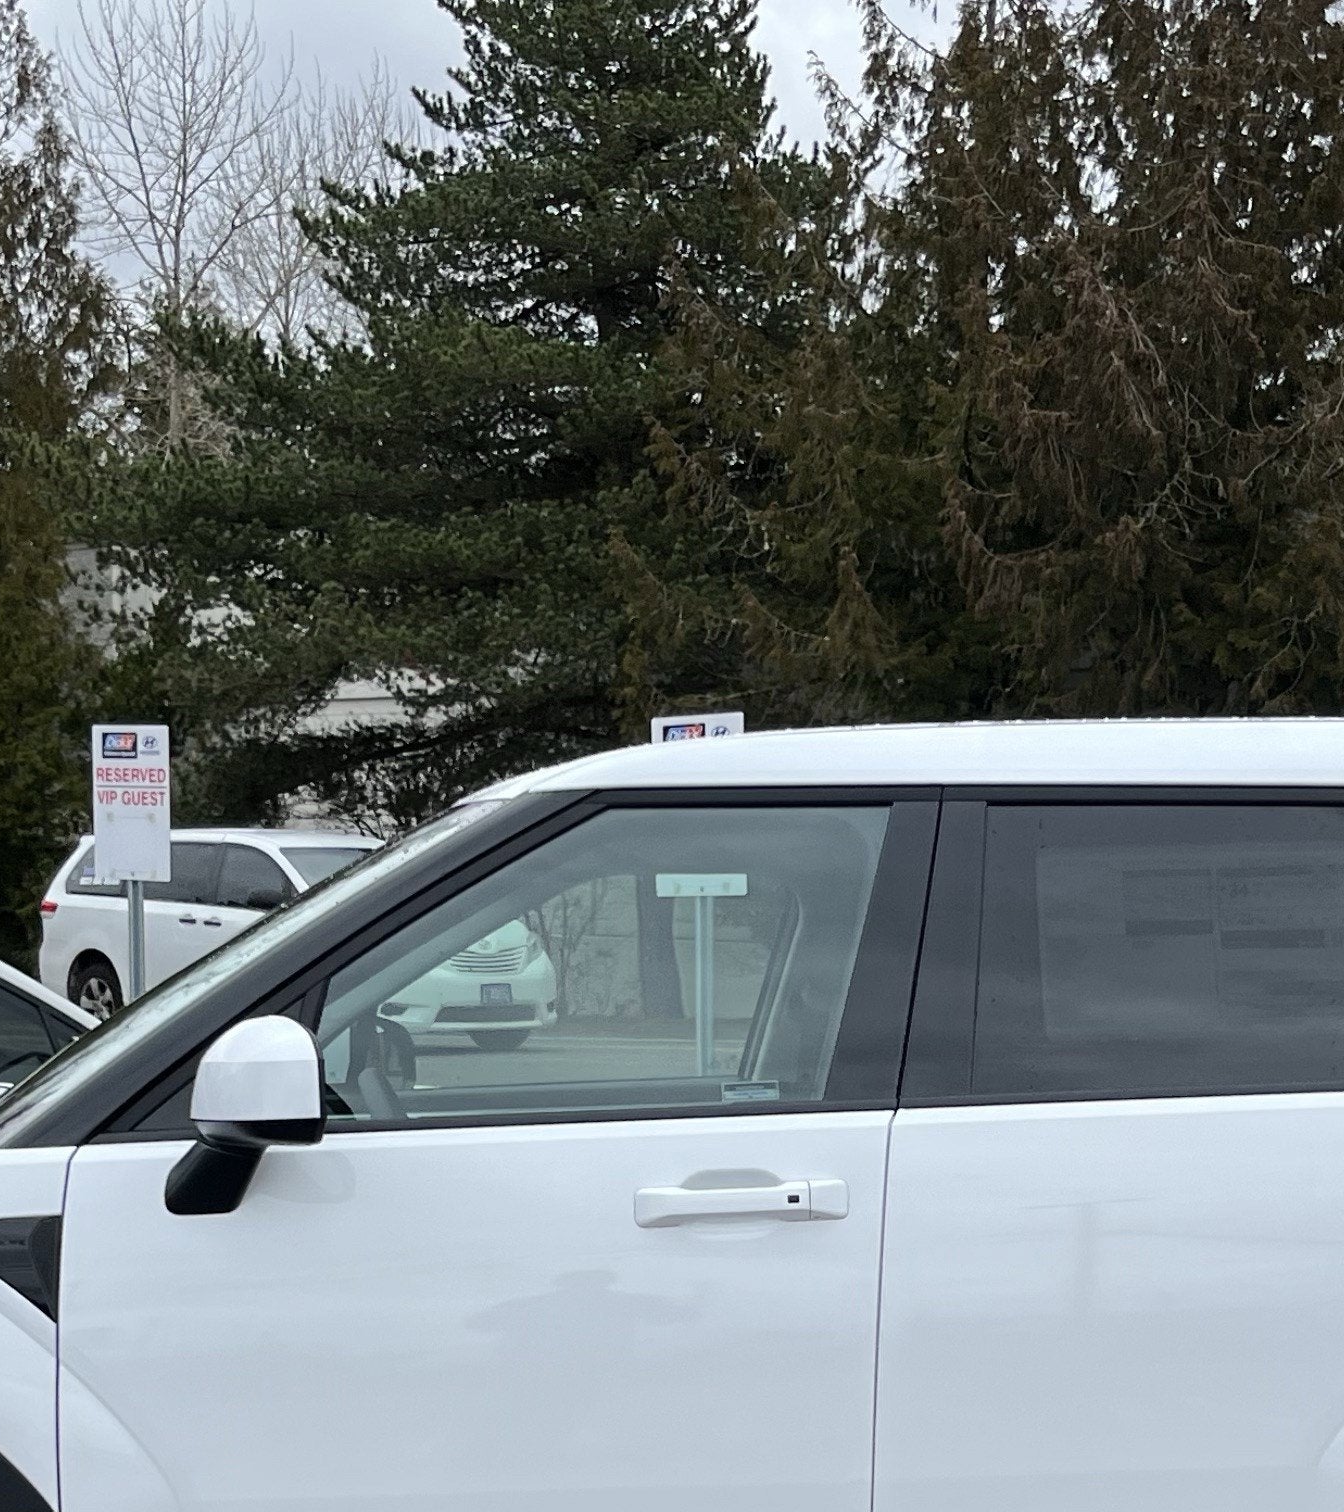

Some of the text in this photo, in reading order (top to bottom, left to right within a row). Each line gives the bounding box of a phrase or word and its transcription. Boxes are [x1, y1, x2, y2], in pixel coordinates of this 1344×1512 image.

[95, 767, 167, 783] RESERVED
[97, 790, 166, 806] VIP GUEST
